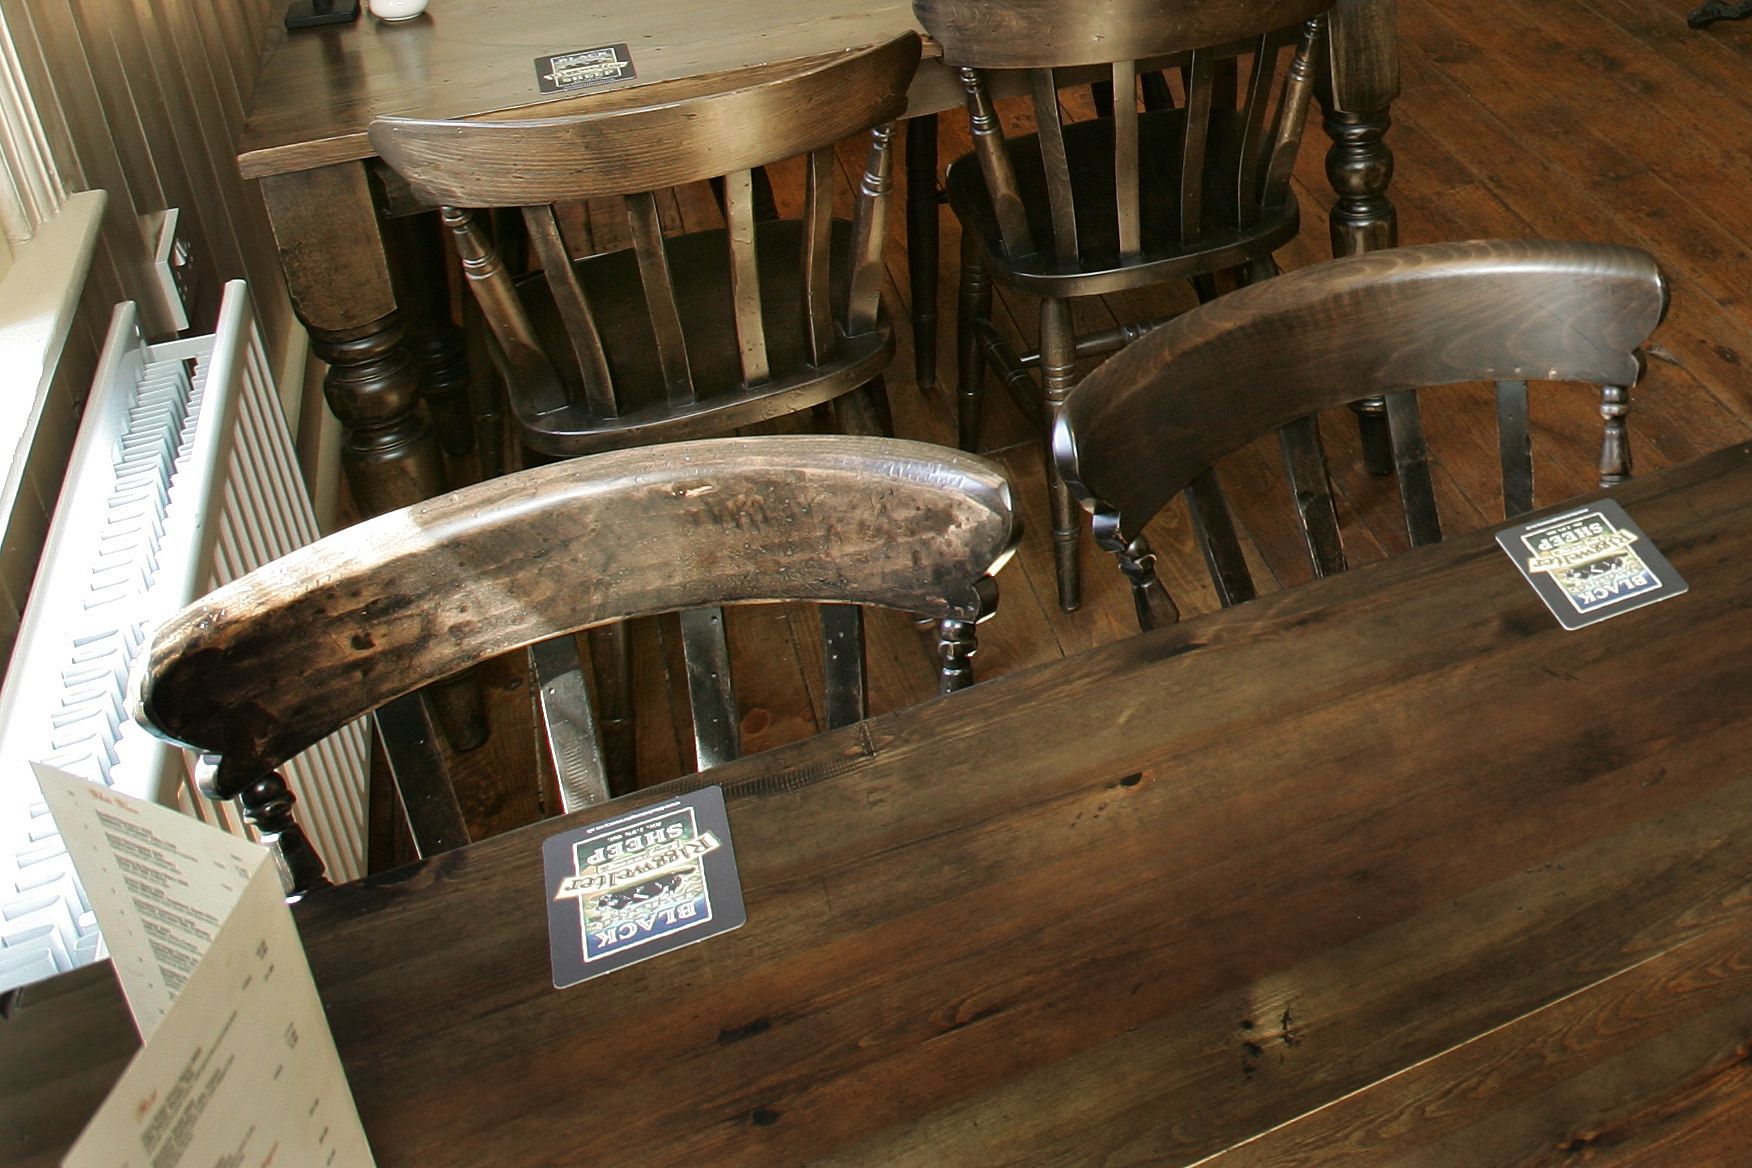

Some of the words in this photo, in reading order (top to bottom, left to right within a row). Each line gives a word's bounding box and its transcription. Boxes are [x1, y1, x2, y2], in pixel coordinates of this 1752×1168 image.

[1538, 522, 1605, 551] SHEEP
[1577, 576, 1648, 605] BLACK
[586, 823, 684, 865] SHEEP
[563, 836, 714, 895] Riggwelter
[595, 901, 698, 948] BLACK
